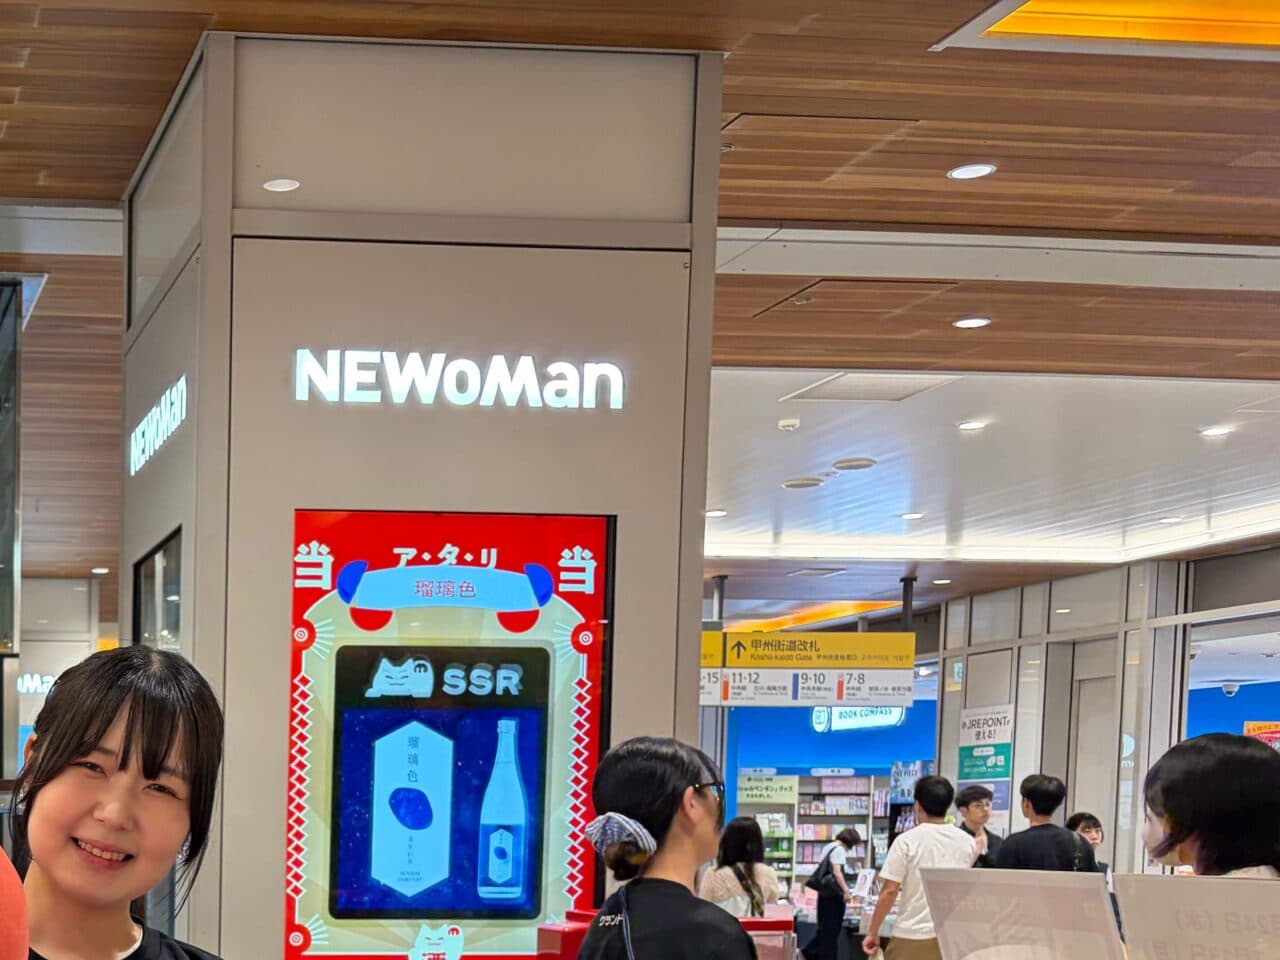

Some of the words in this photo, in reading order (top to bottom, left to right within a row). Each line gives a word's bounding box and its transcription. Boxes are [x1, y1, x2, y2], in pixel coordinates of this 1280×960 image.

[295, 348, 624, 410] NEWoMan
[130, 374, 187, 476] NEWoMan
[293, 540, 335, 590] 当
[557, 544, 598, 595] 当
[415, 579, 477, 600] 瑠璃色
[751, 639, 821, 652] 甲州街道改札
[442, 662, 524, 698] SSR
[838, 710, 858, 720] BOOK
